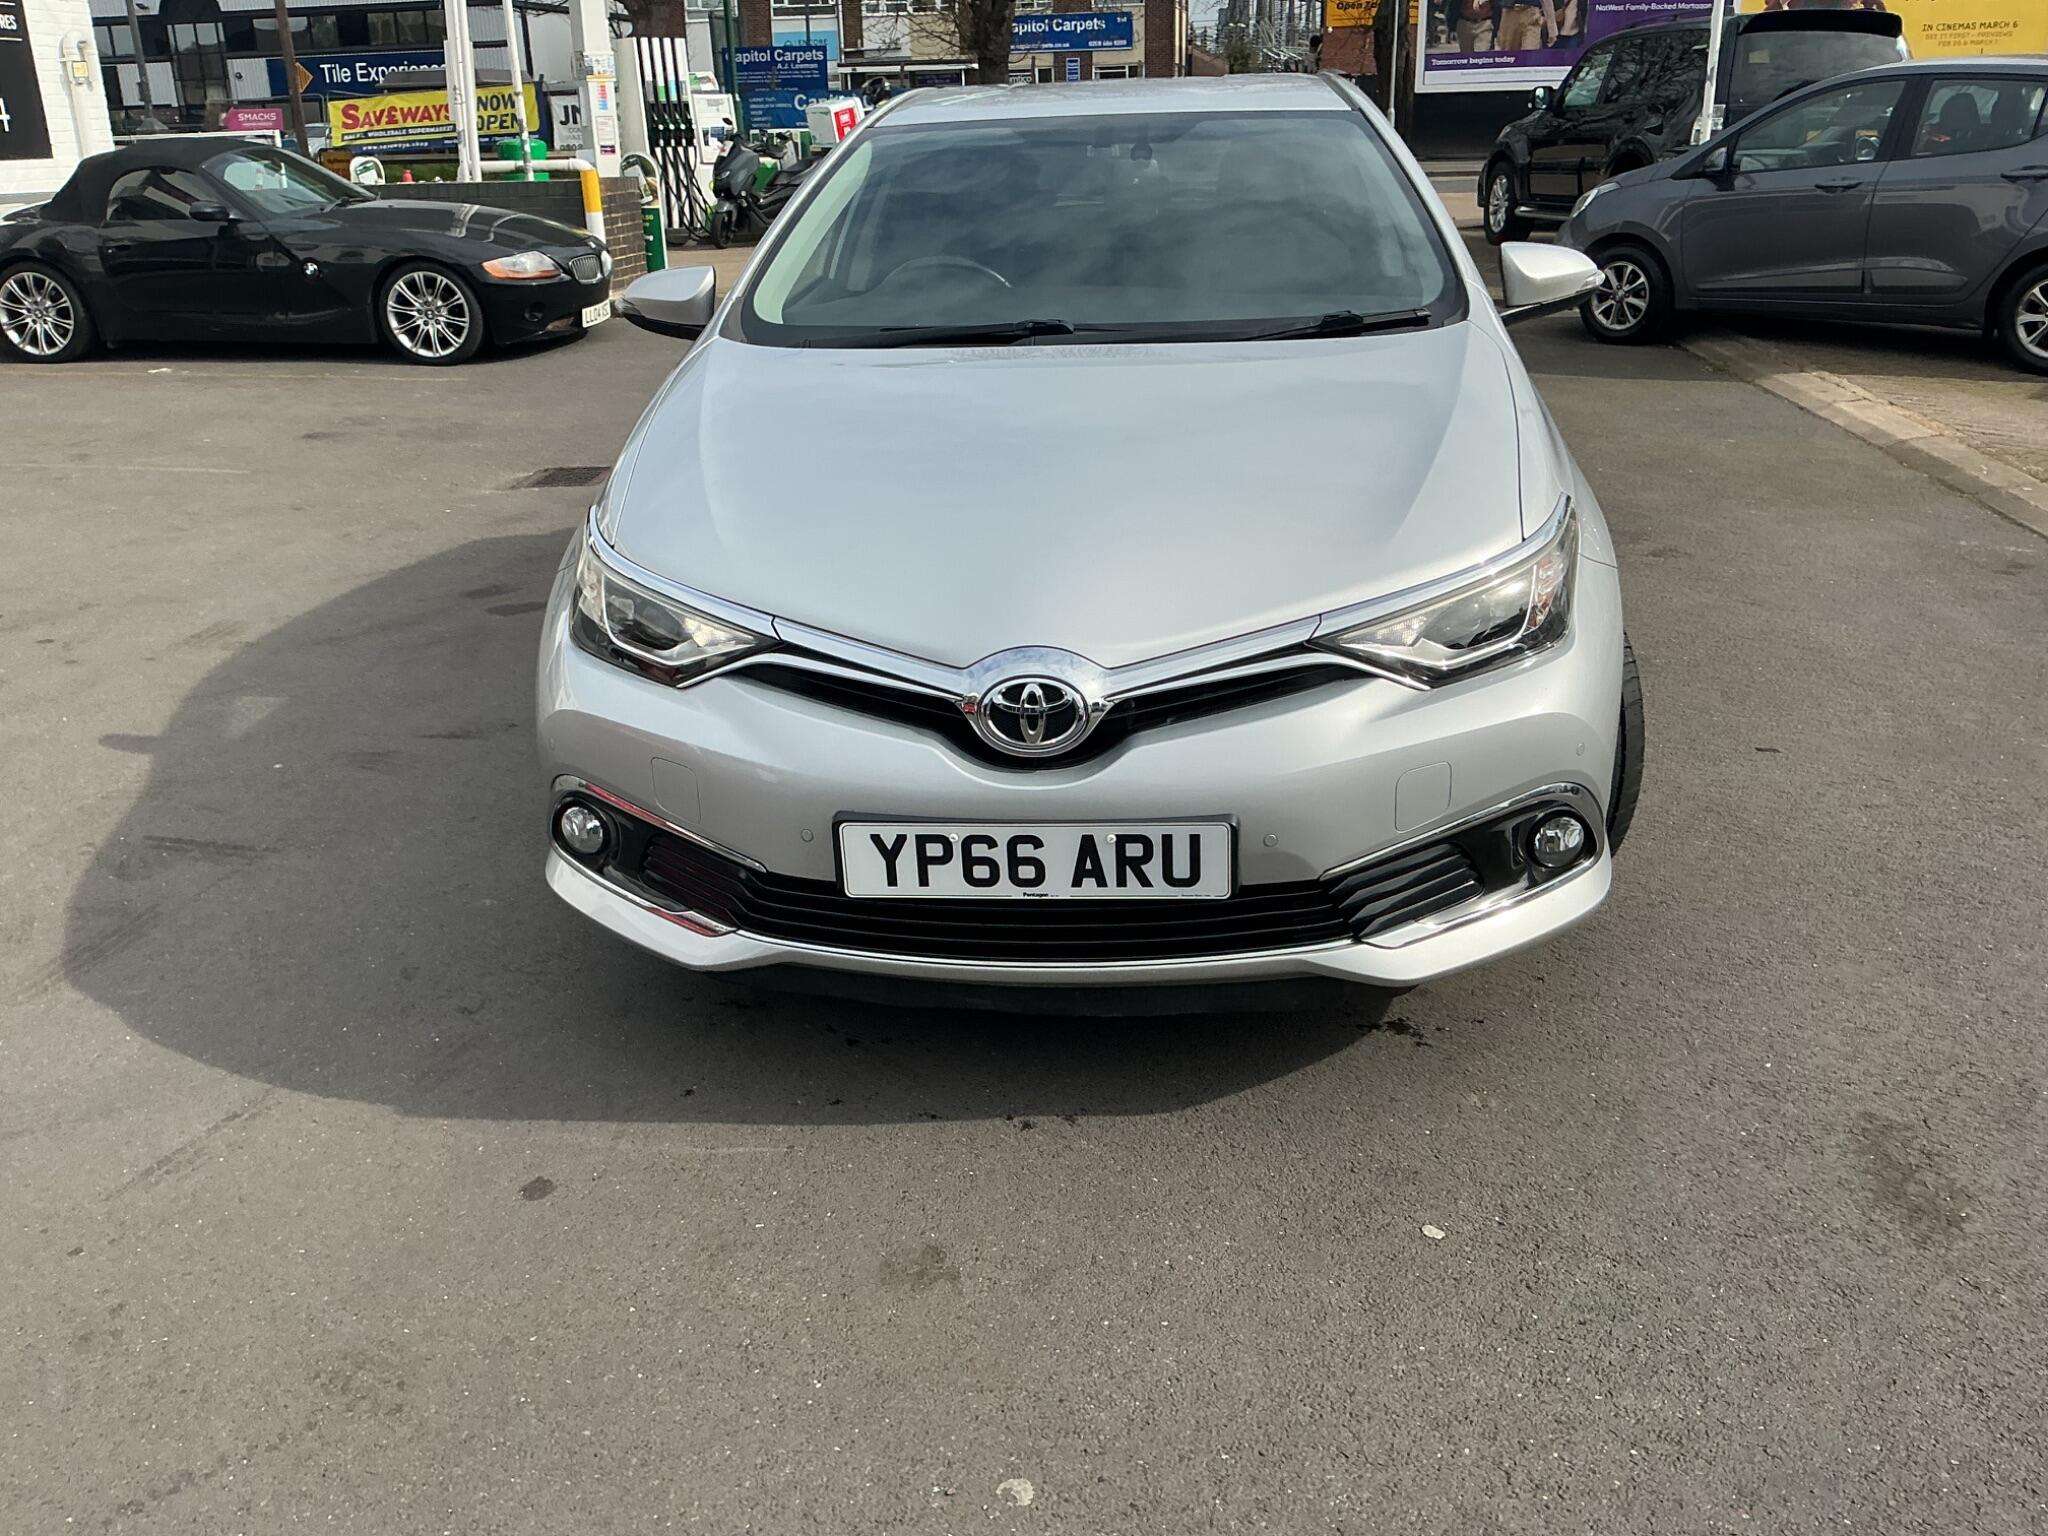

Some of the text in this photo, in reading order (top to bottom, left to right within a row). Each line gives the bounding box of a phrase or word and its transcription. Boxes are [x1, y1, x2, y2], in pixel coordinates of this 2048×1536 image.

[1625, 2, 1677, 12] Family-Backed
[1012, 19, 1049, 35] apitol
[1053, 17, 1106, 33] Carpets
[1921, 20, 2018, 32] IN CINEMAS MARCH 6
[725, 49, 824, 64] apitol Carpets
[1469, 57, 1493, 65] begins
[319, 63, 351, 83] Tile
[477, 93, 516, 111] NOW
[238, 112, 277, 121] SMACKS
[477, 113, 522, 131] OPEN
[367, 128, 407, 138] WHOLESALE
[408, 125, 454, 134] SUPERMARKET
[869, 833, 1201, 889] YP66 ARU
